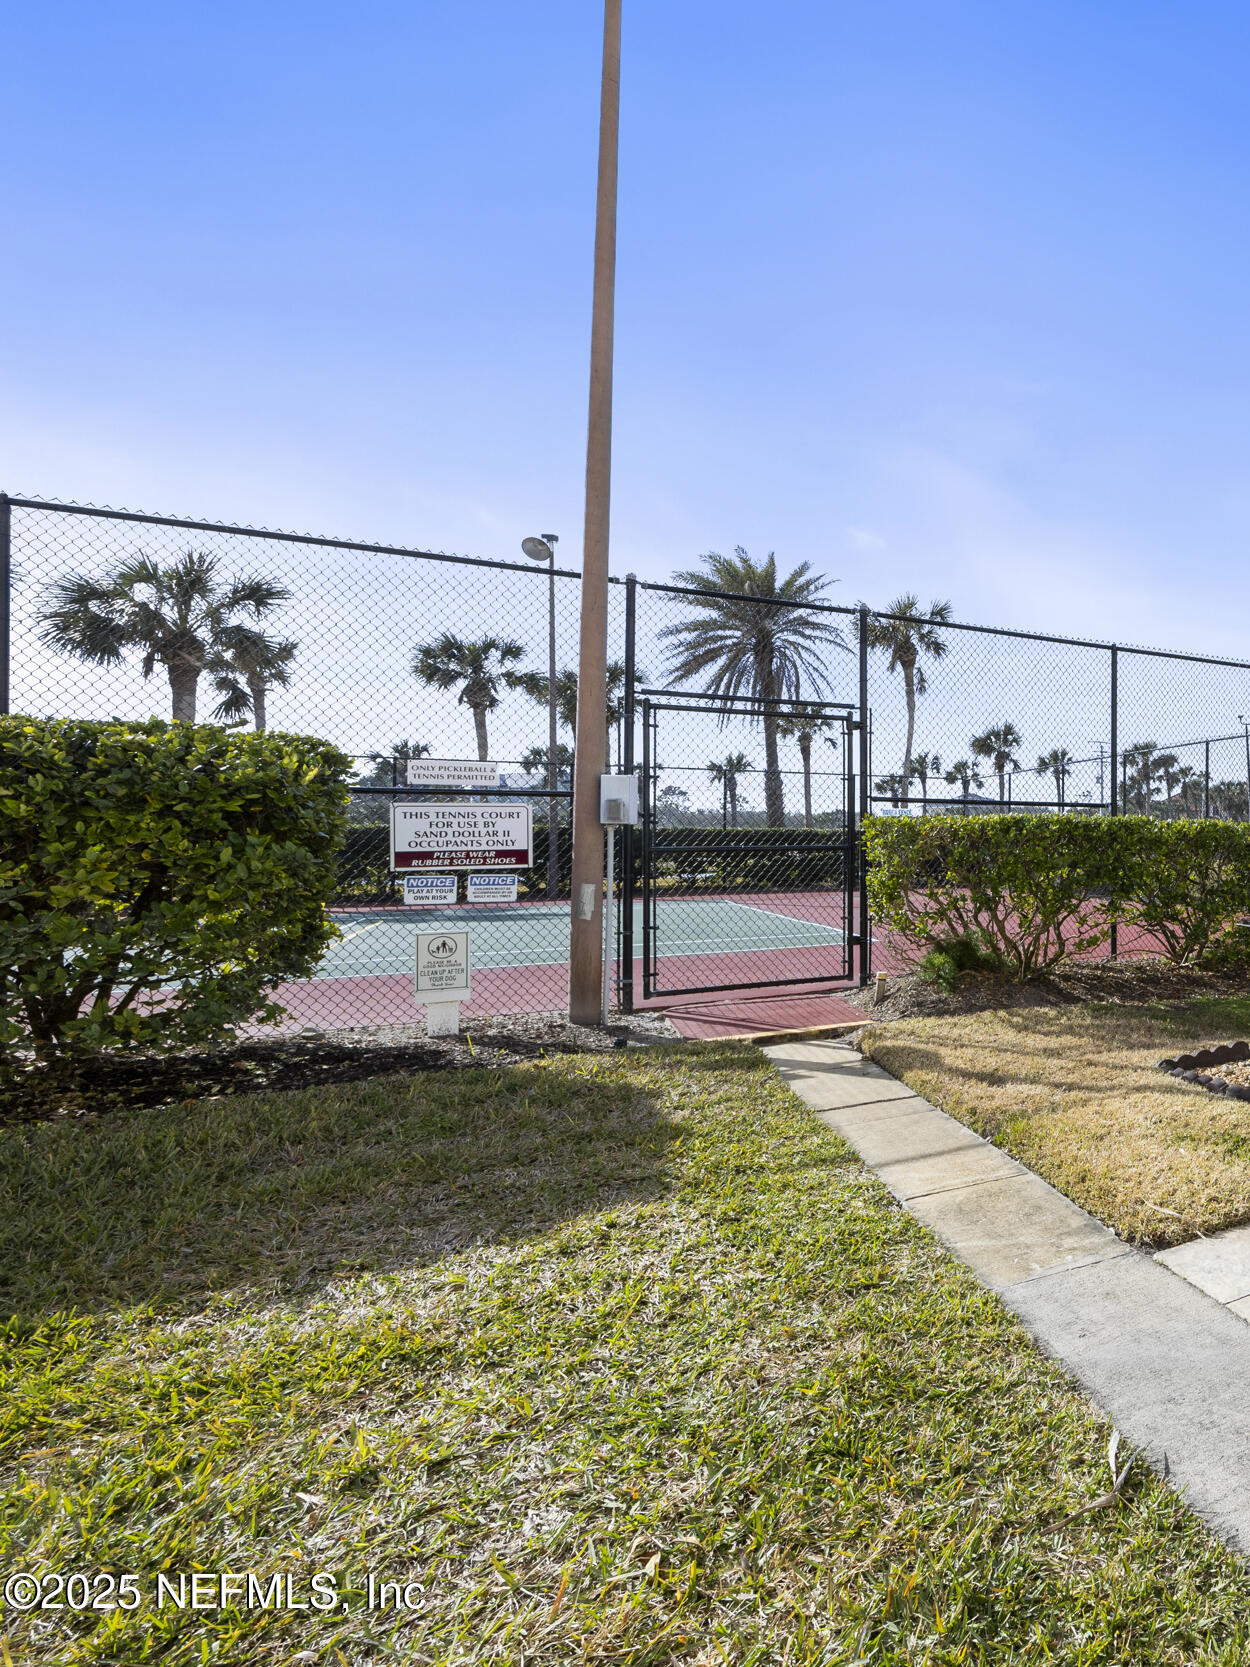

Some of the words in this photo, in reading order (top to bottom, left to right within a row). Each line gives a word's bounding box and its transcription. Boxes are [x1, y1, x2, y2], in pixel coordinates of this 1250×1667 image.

[438, 765, 488, 773] PICKLEBALL
[408, 840, 482, 848] OCCUPANTS
[412, 858, 450, 866] RUBBER
[408, 878, 454, 887] NOTICE
[472, 876, 515, 885] NOTICE
